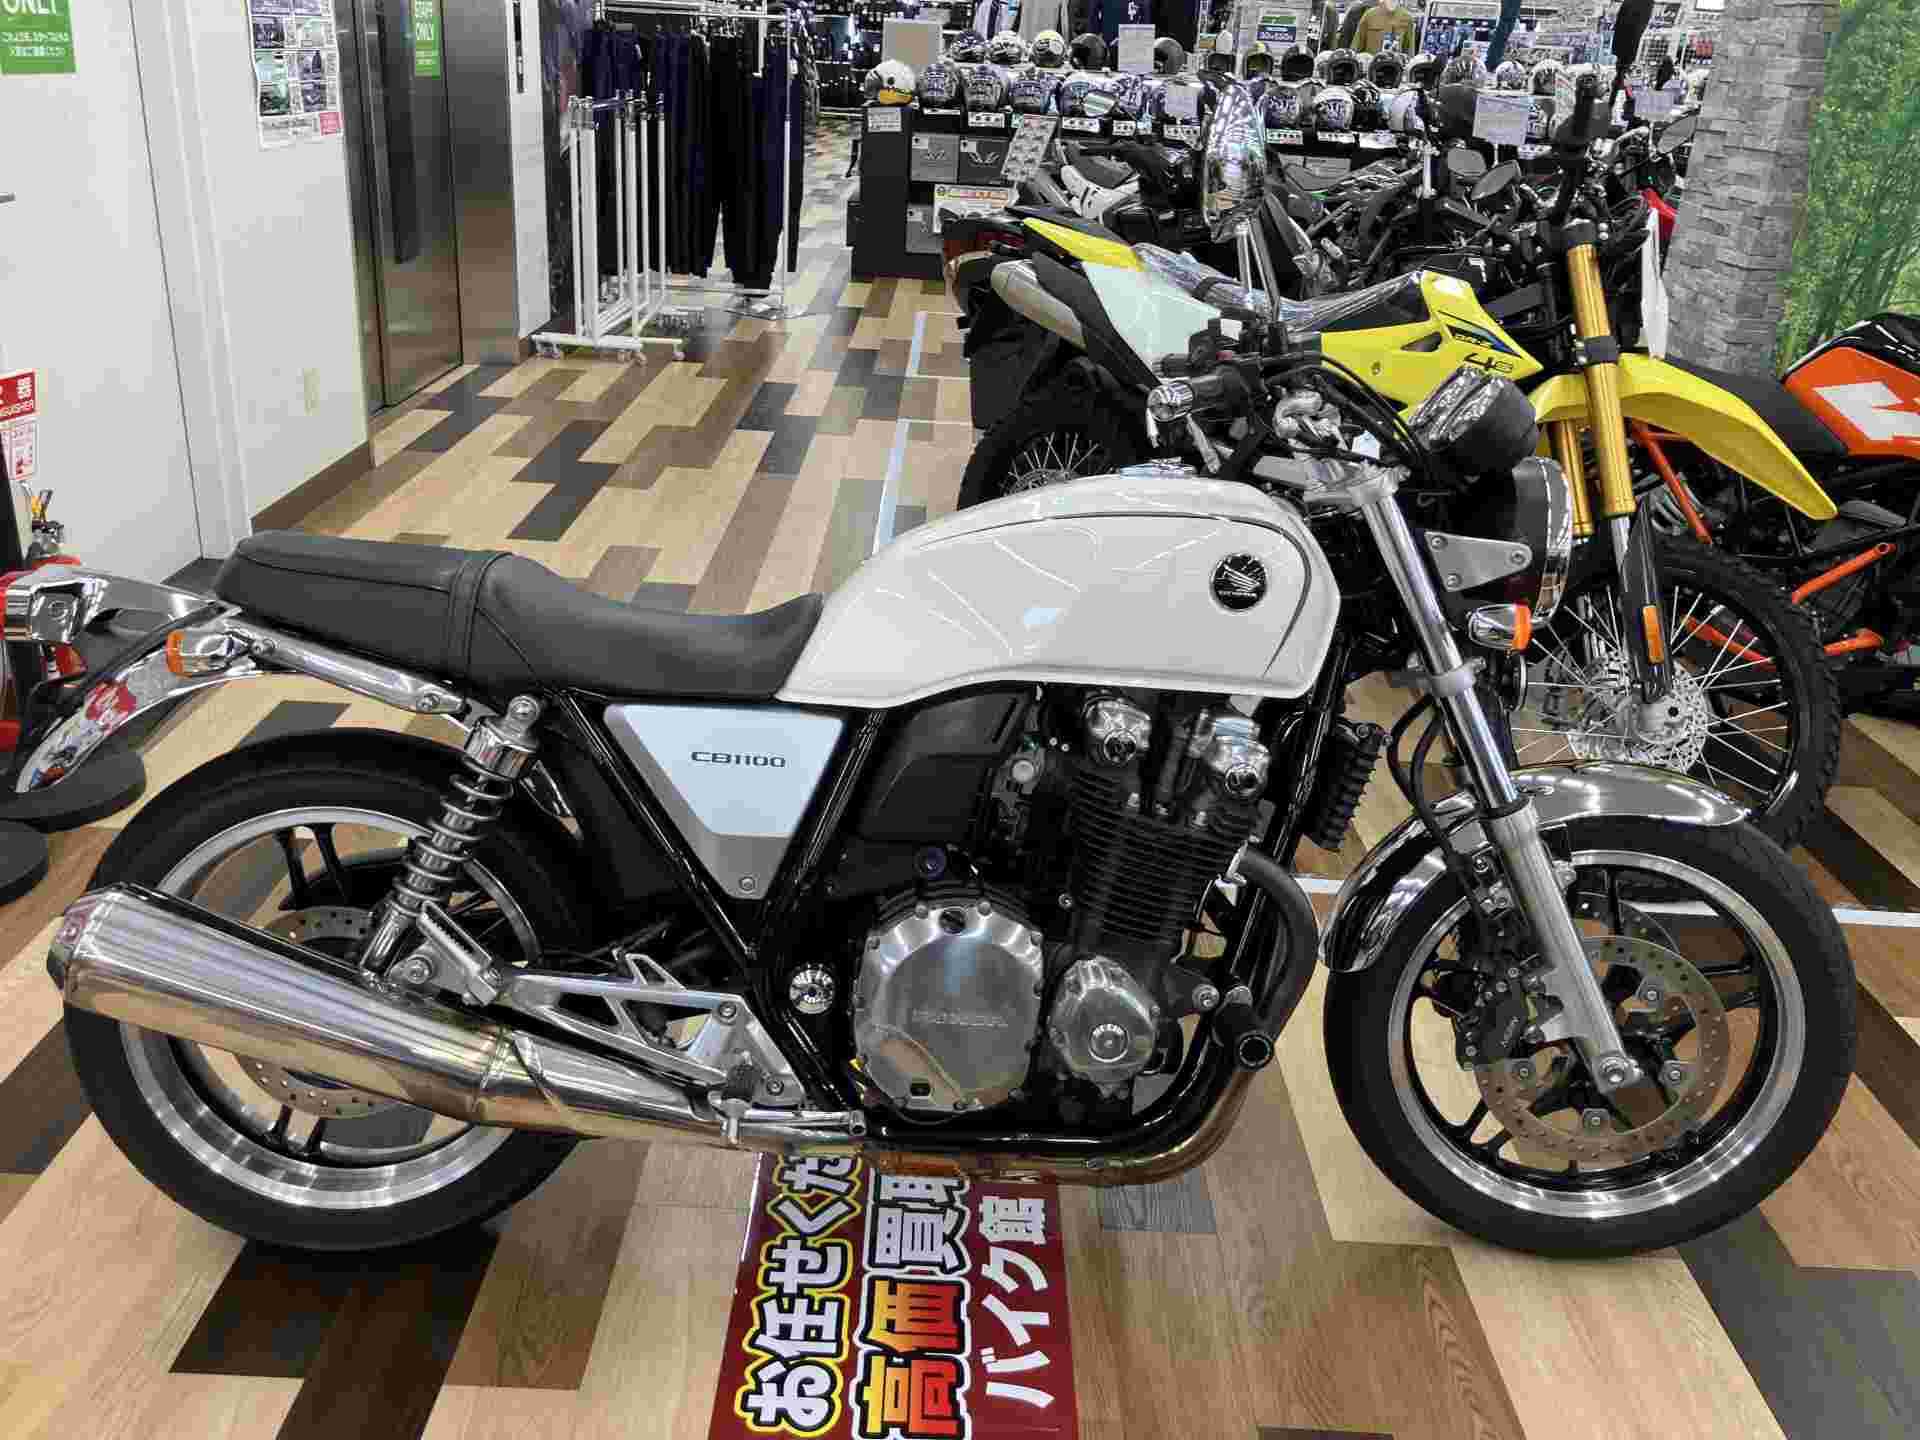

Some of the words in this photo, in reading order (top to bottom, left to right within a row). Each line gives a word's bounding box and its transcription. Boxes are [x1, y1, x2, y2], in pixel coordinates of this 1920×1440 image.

[690, 751, 786, 768] CB1100
[979, 1195, 1055, 1408] バイク館
